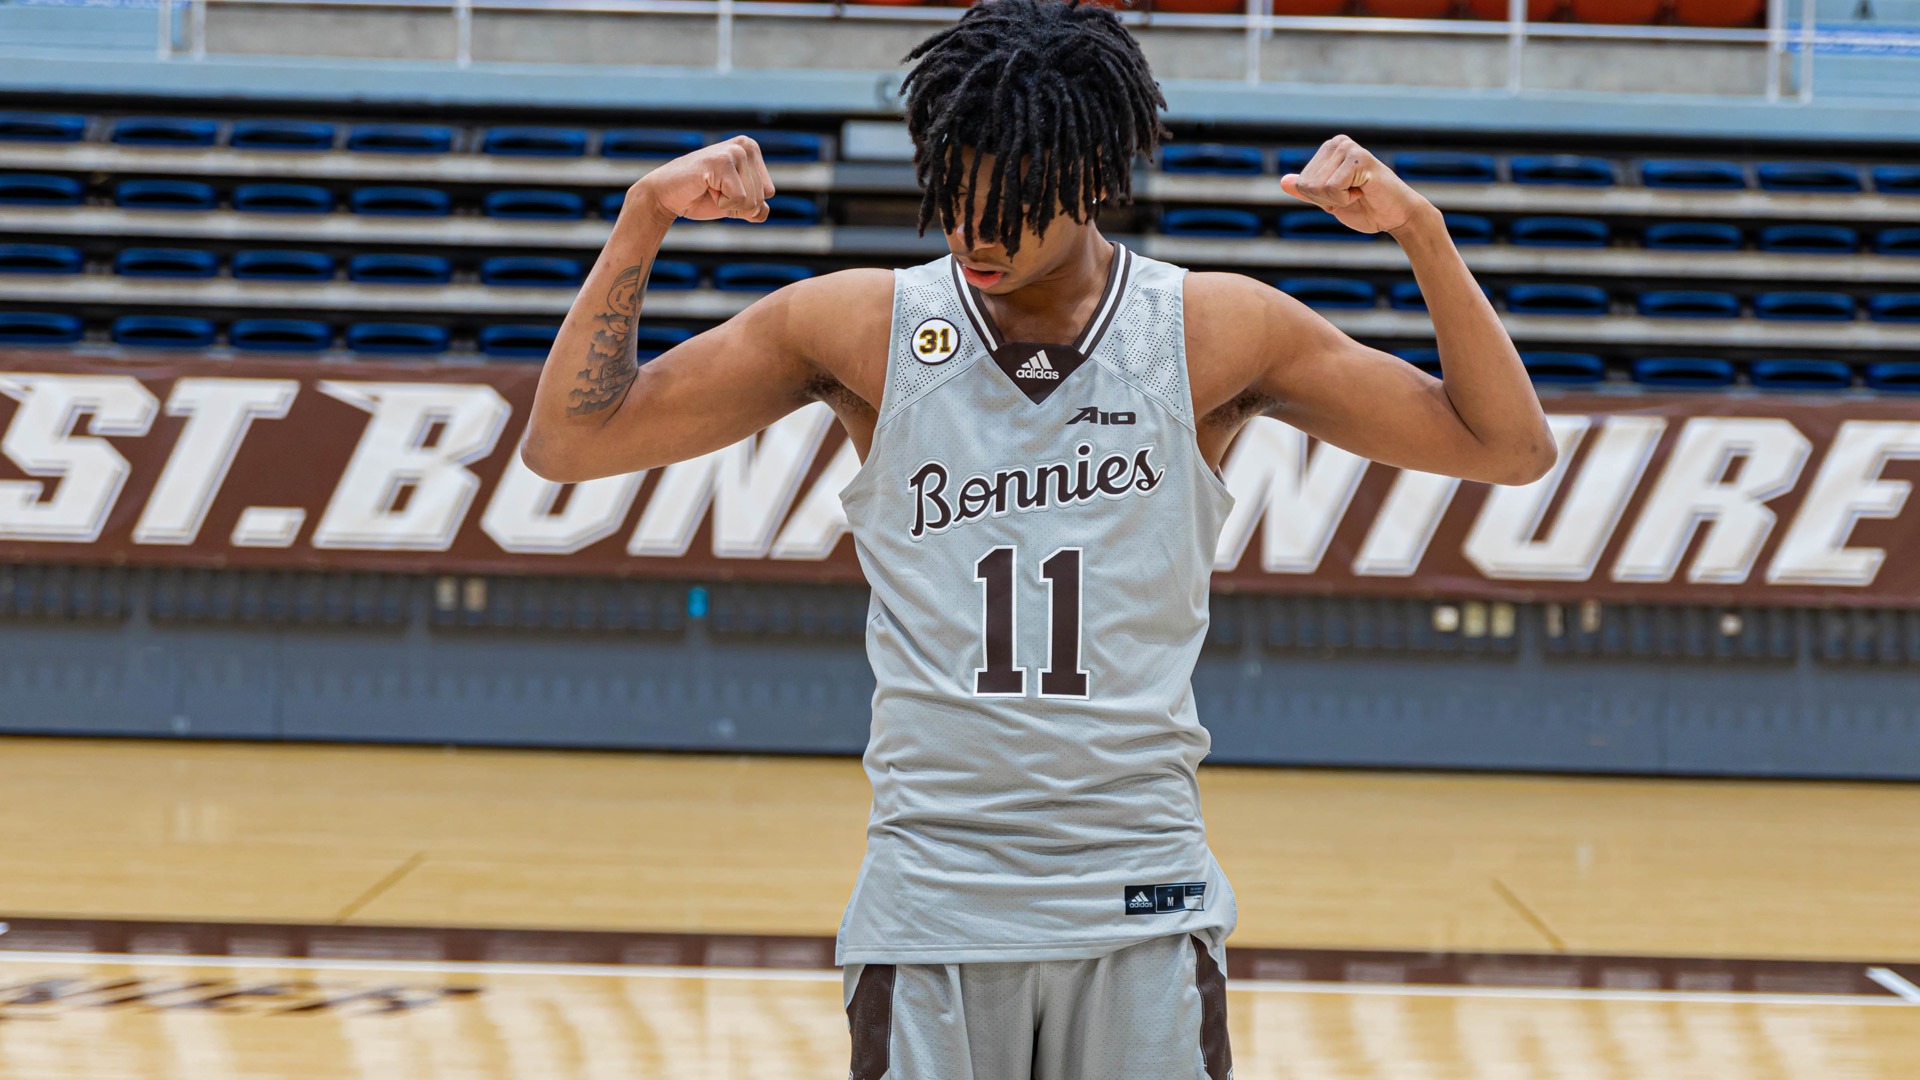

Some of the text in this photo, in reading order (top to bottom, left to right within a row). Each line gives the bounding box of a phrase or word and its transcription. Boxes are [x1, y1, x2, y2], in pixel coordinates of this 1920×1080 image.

[918, 327, 952, 355] 31
[1015, 367, 1060, 380] adidas
[1065, 406, 1137, 426] A10
[908, 441, 1166, 540] Bonnies
[973, 544, 1090, 700] 11
[1167, 896, 1174, 907] M
